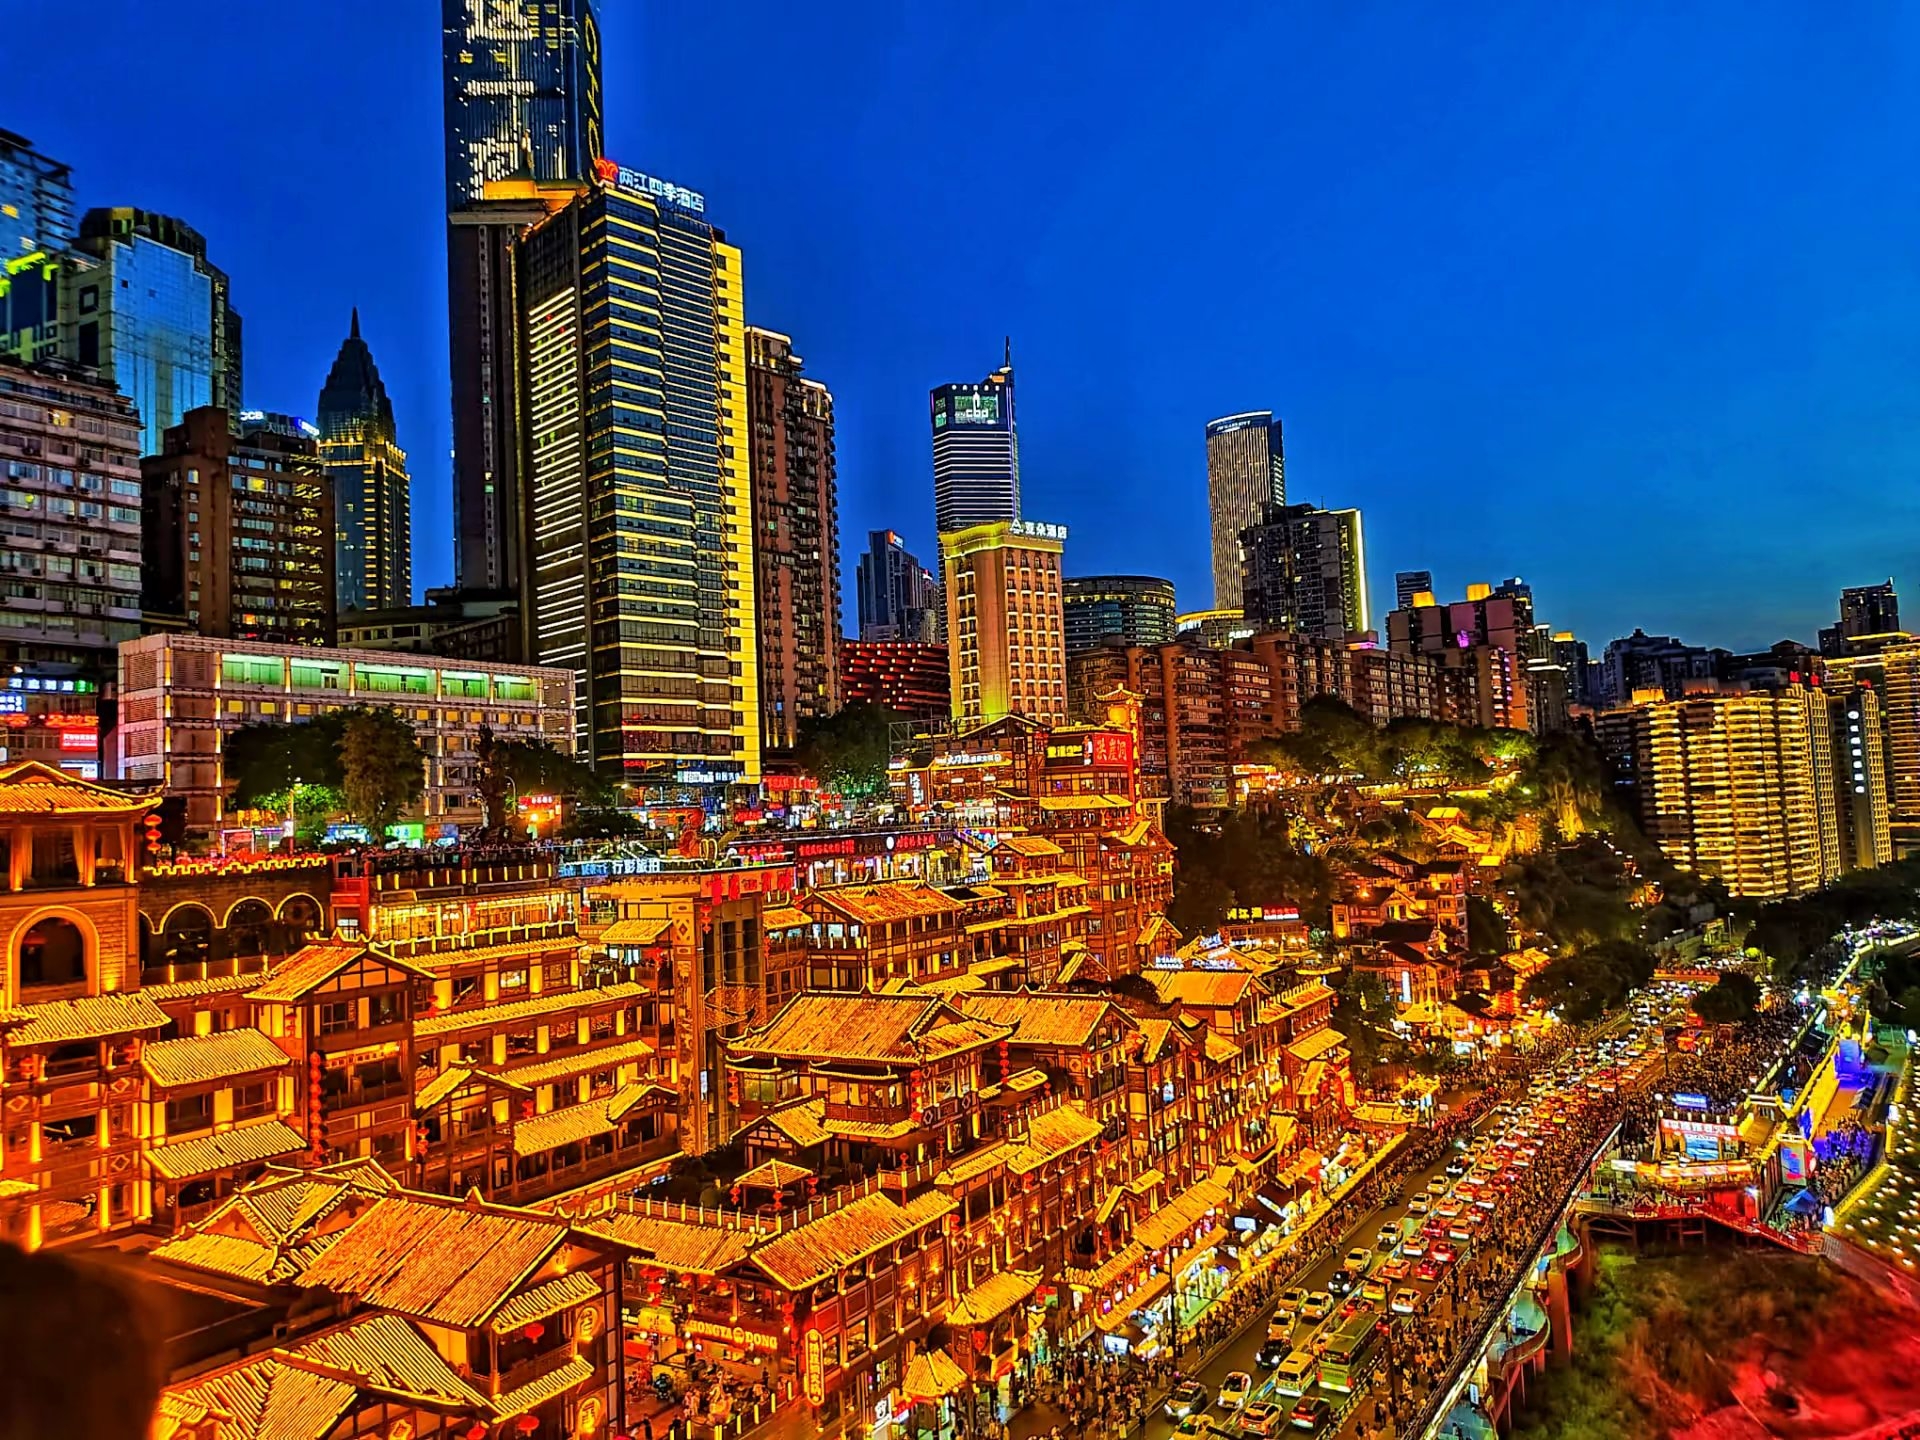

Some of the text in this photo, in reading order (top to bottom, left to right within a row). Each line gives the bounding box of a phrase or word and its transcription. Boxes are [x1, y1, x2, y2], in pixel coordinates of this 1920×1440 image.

[618, 166, 704, 212] 两江四季酒店
[1024, 521, 1067, 539] 亚朵酒店
[744, 1330, 778, 1349] DONG
